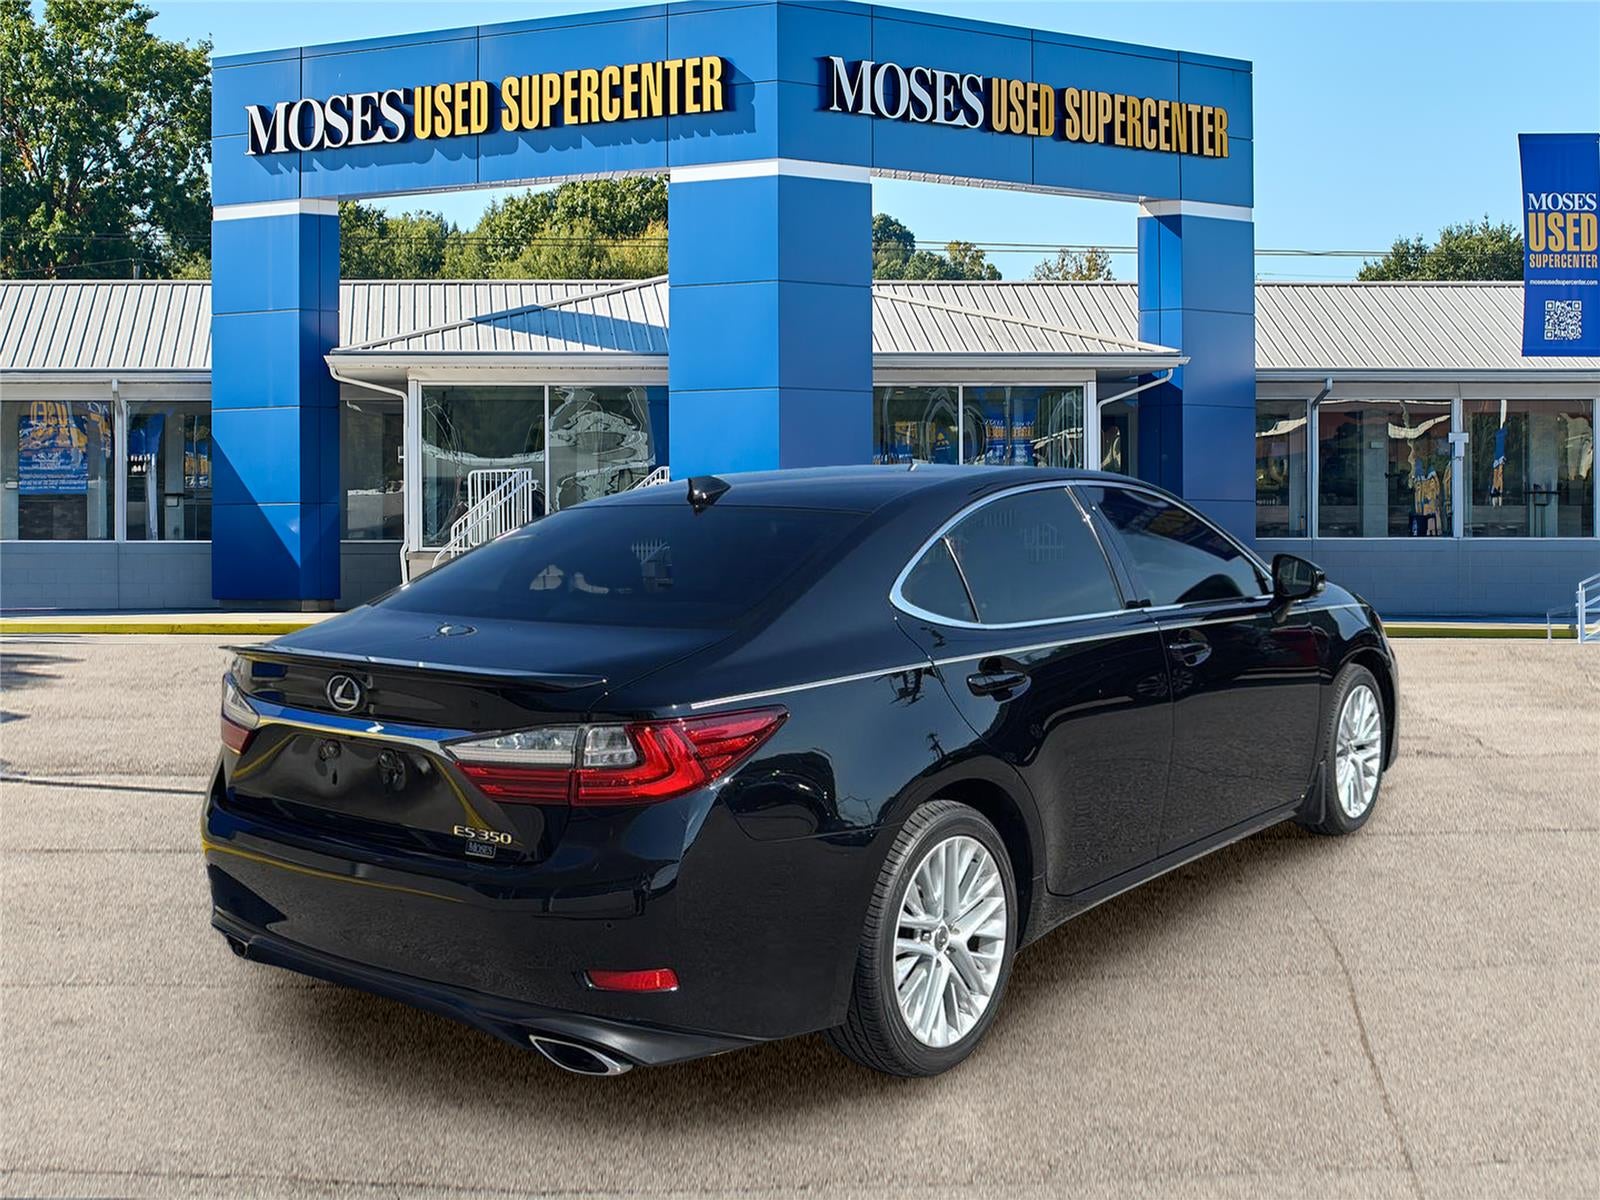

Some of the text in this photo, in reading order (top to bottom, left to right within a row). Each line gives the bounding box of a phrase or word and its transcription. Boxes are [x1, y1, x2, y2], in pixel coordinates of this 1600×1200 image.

[244, 56, 724, 156] MOSES USED SUPERCENTER
[829, 55, 1229, 158] MOSES USED SUPERCENTER
[1528, 193, 1597, 211] MOSES
[1528, 212, 1598, 252] USED
[1529, 253, 1598, 269] SUPERCENTER
[453, 825, 512, 844] ES 350
